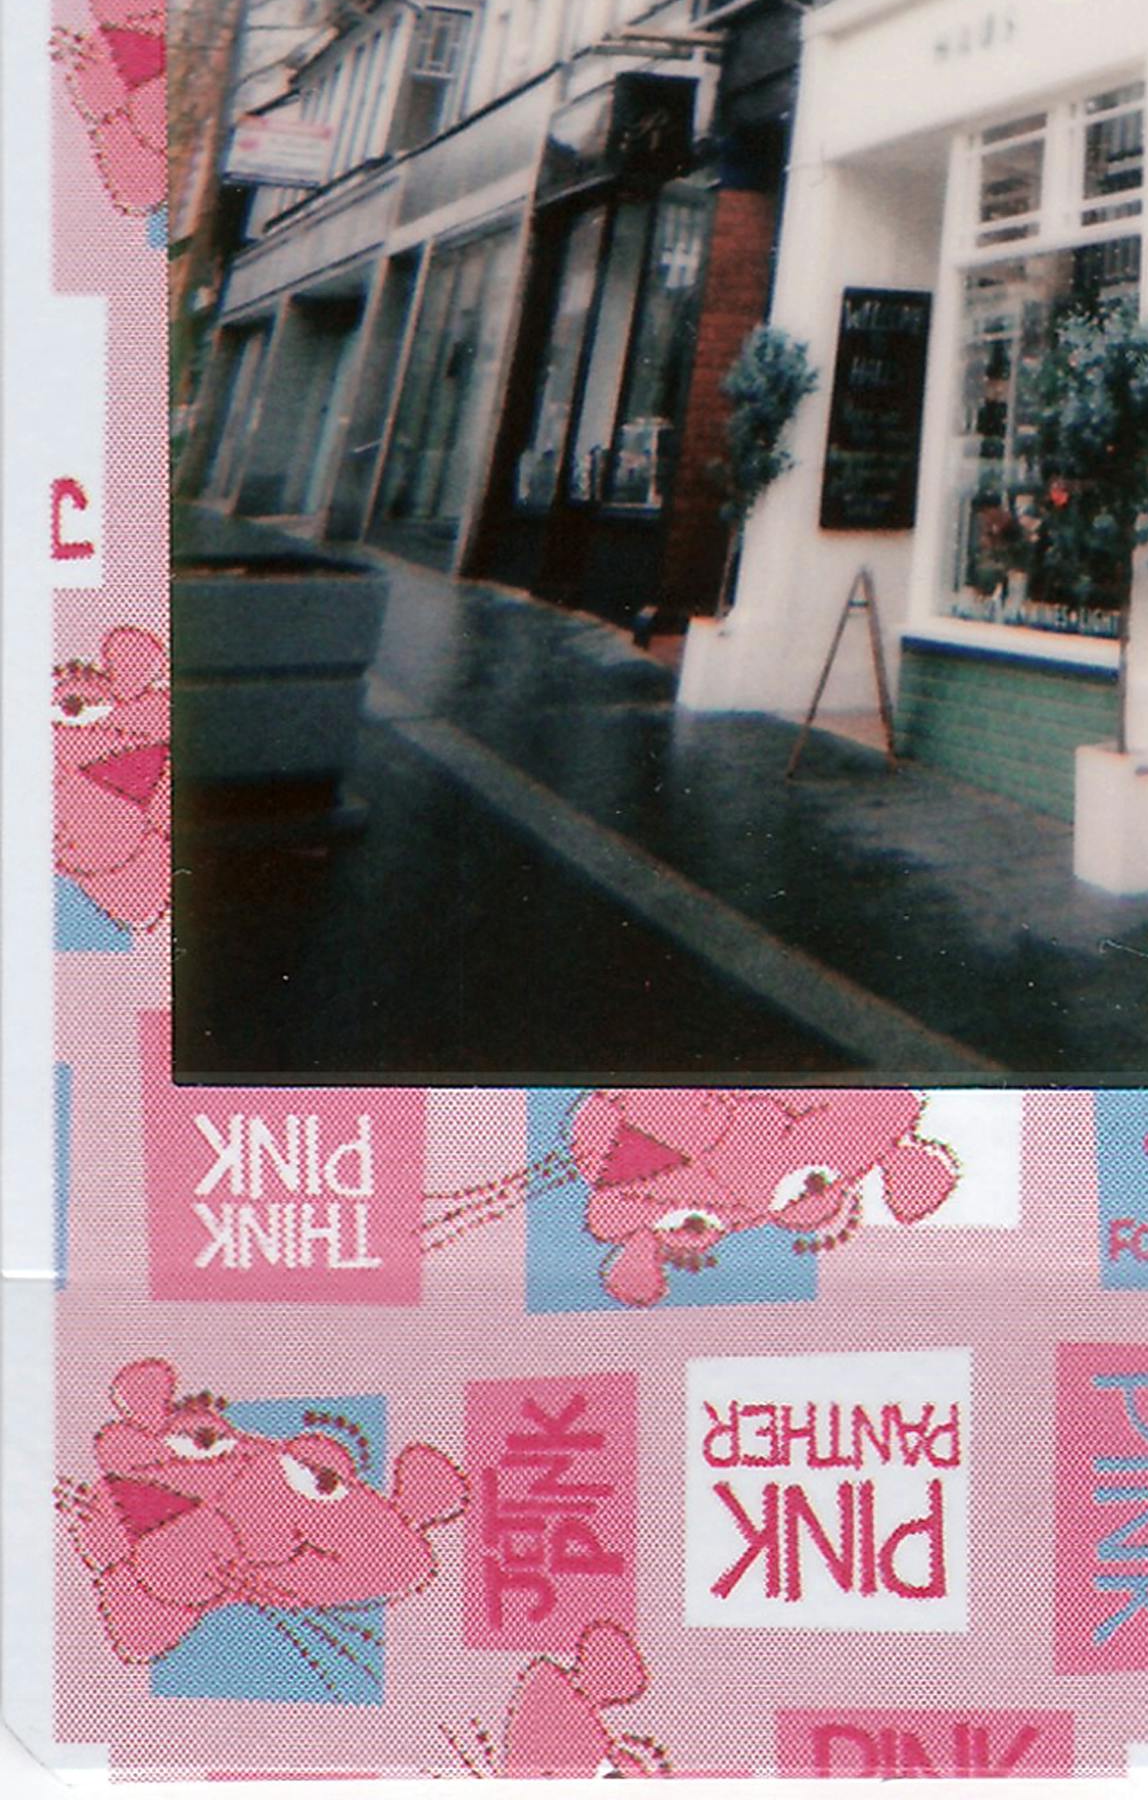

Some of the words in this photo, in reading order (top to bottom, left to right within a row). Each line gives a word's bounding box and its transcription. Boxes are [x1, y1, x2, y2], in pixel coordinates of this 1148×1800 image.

[194, 1113, 374, 1200] PINK
[194, 1203, 382, 1268] THINK
[702, 1400, 960, 1470] PANTHER
[500, 1394, 624, 1576] PINK
[710, 1478, 946, 1602] PINK
